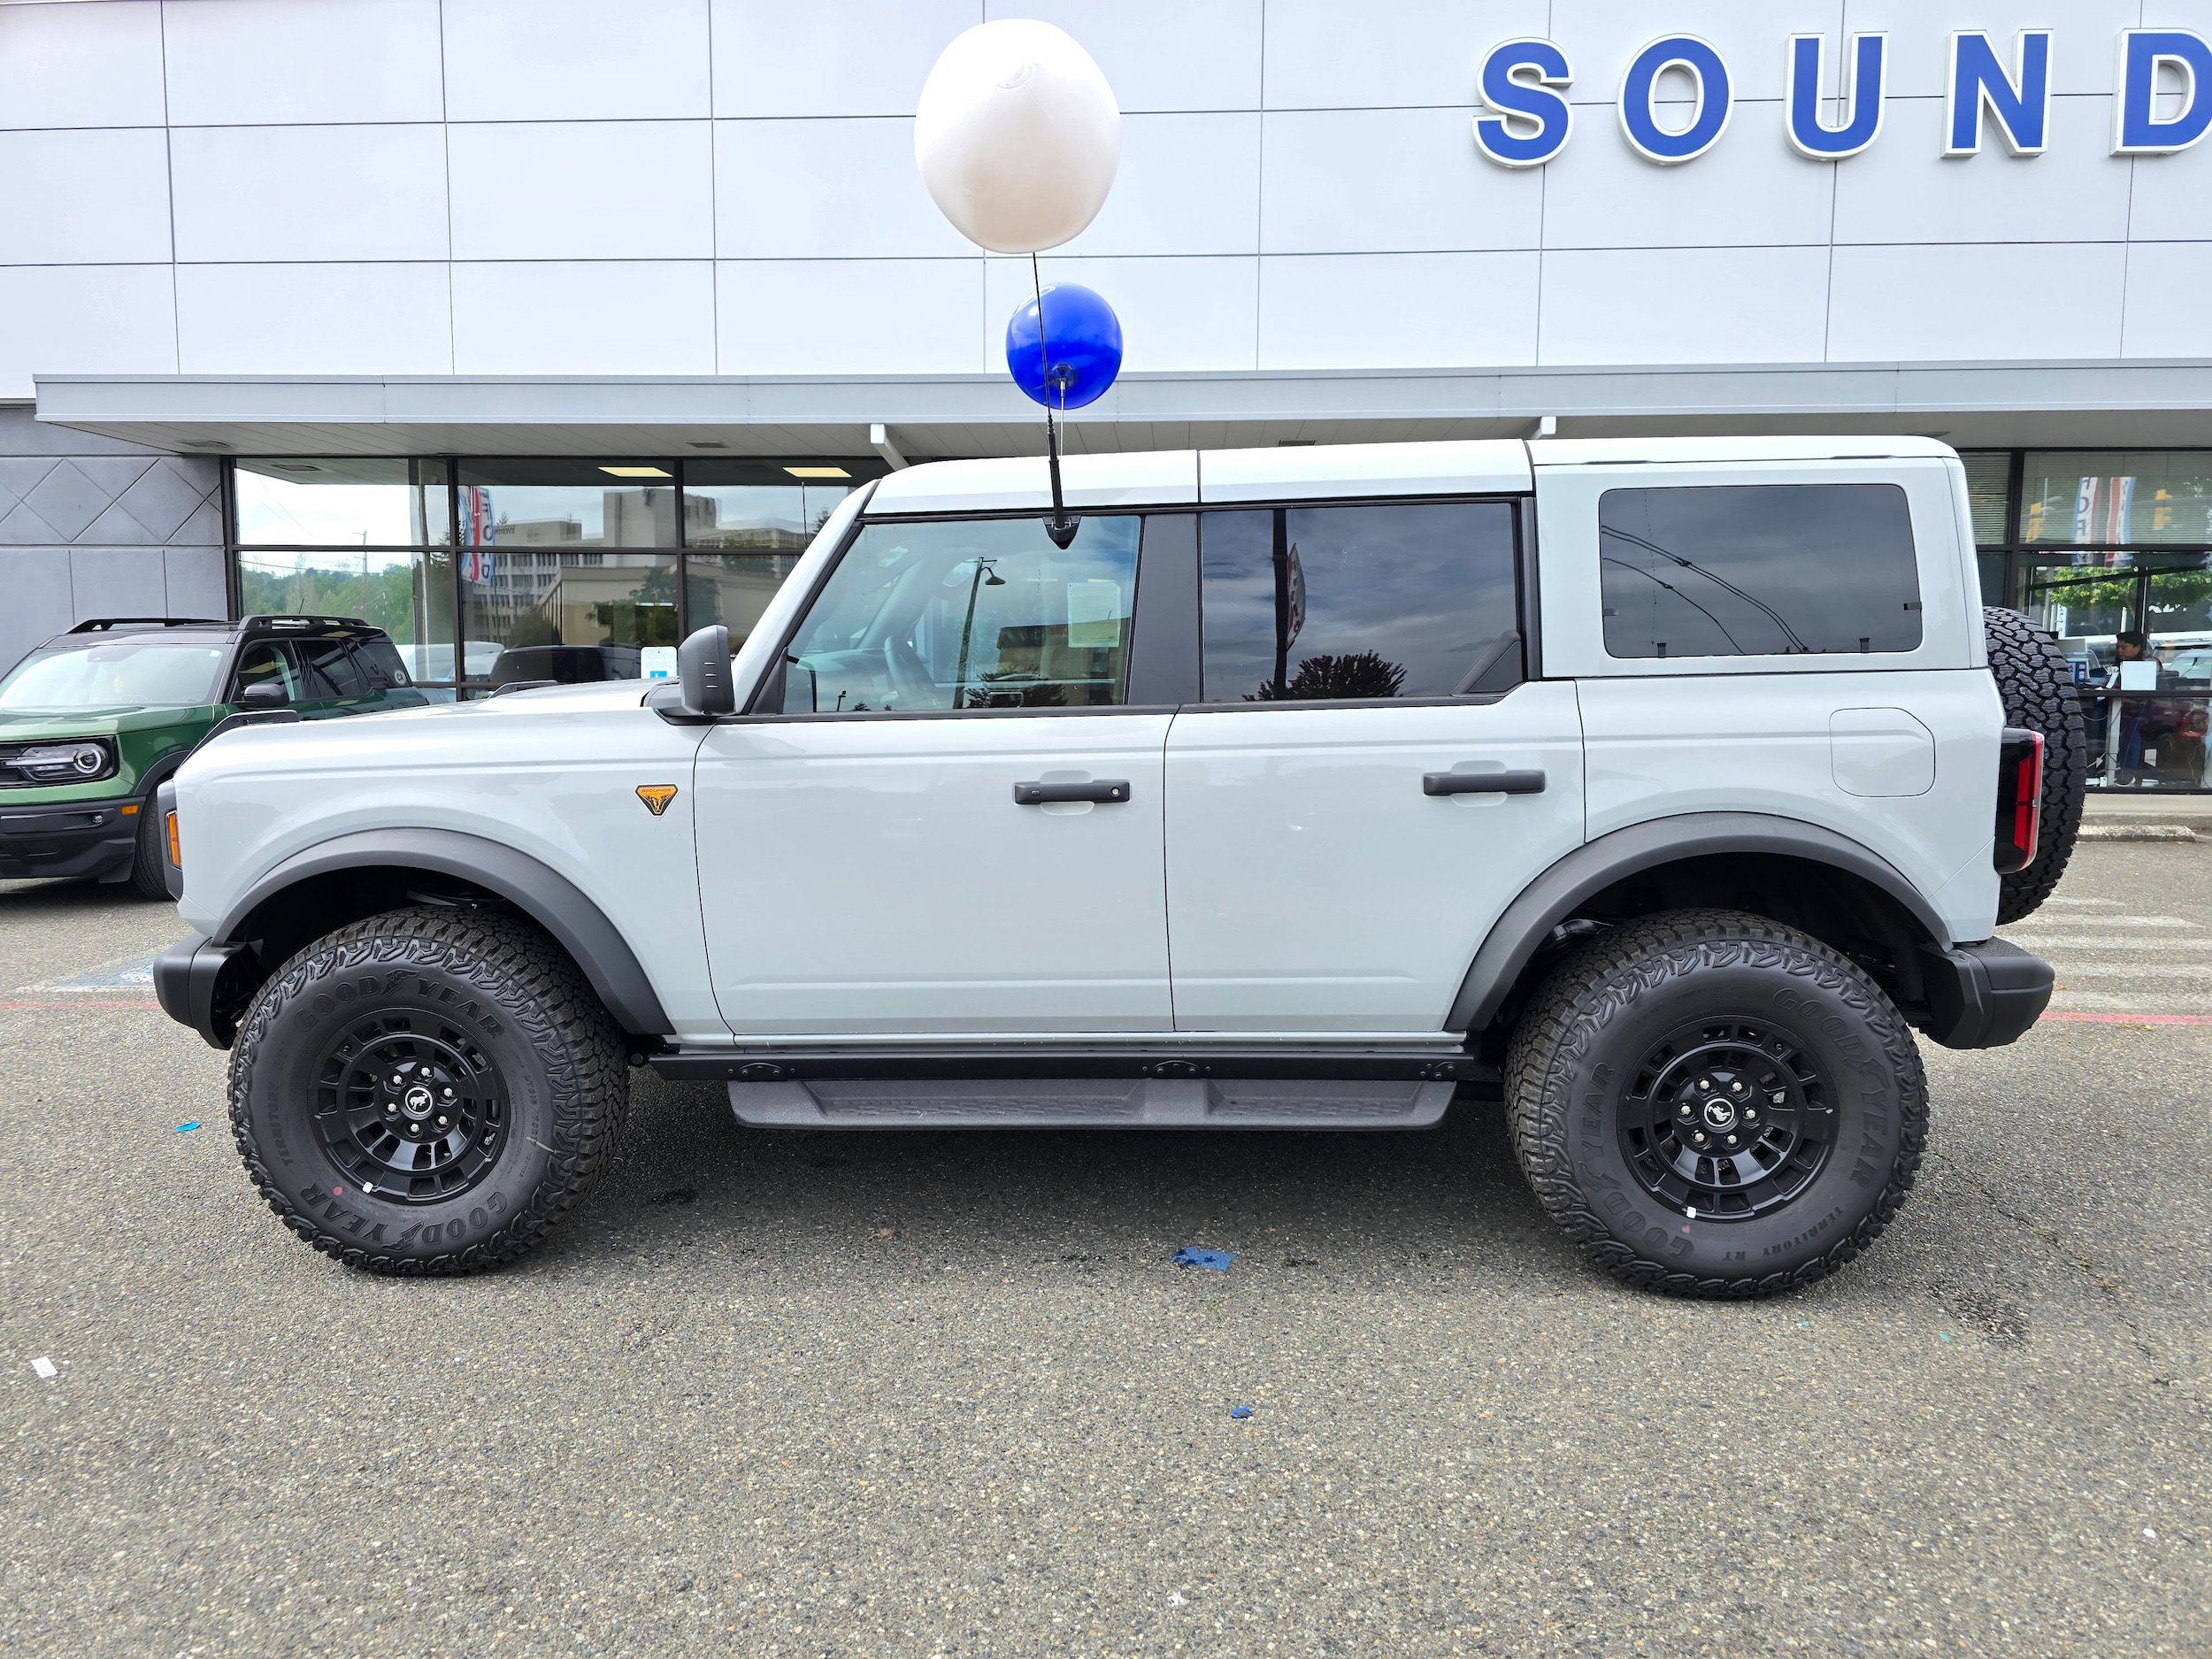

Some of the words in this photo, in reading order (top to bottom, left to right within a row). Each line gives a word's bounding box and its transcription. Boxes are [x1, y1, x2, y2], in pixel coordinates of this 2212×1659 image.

[1472, 28, 2212, 168] SOUND
[1723, 1251, 1746, 1261] RT
[1763, 1205, 1844, 1257] TERRITORY
